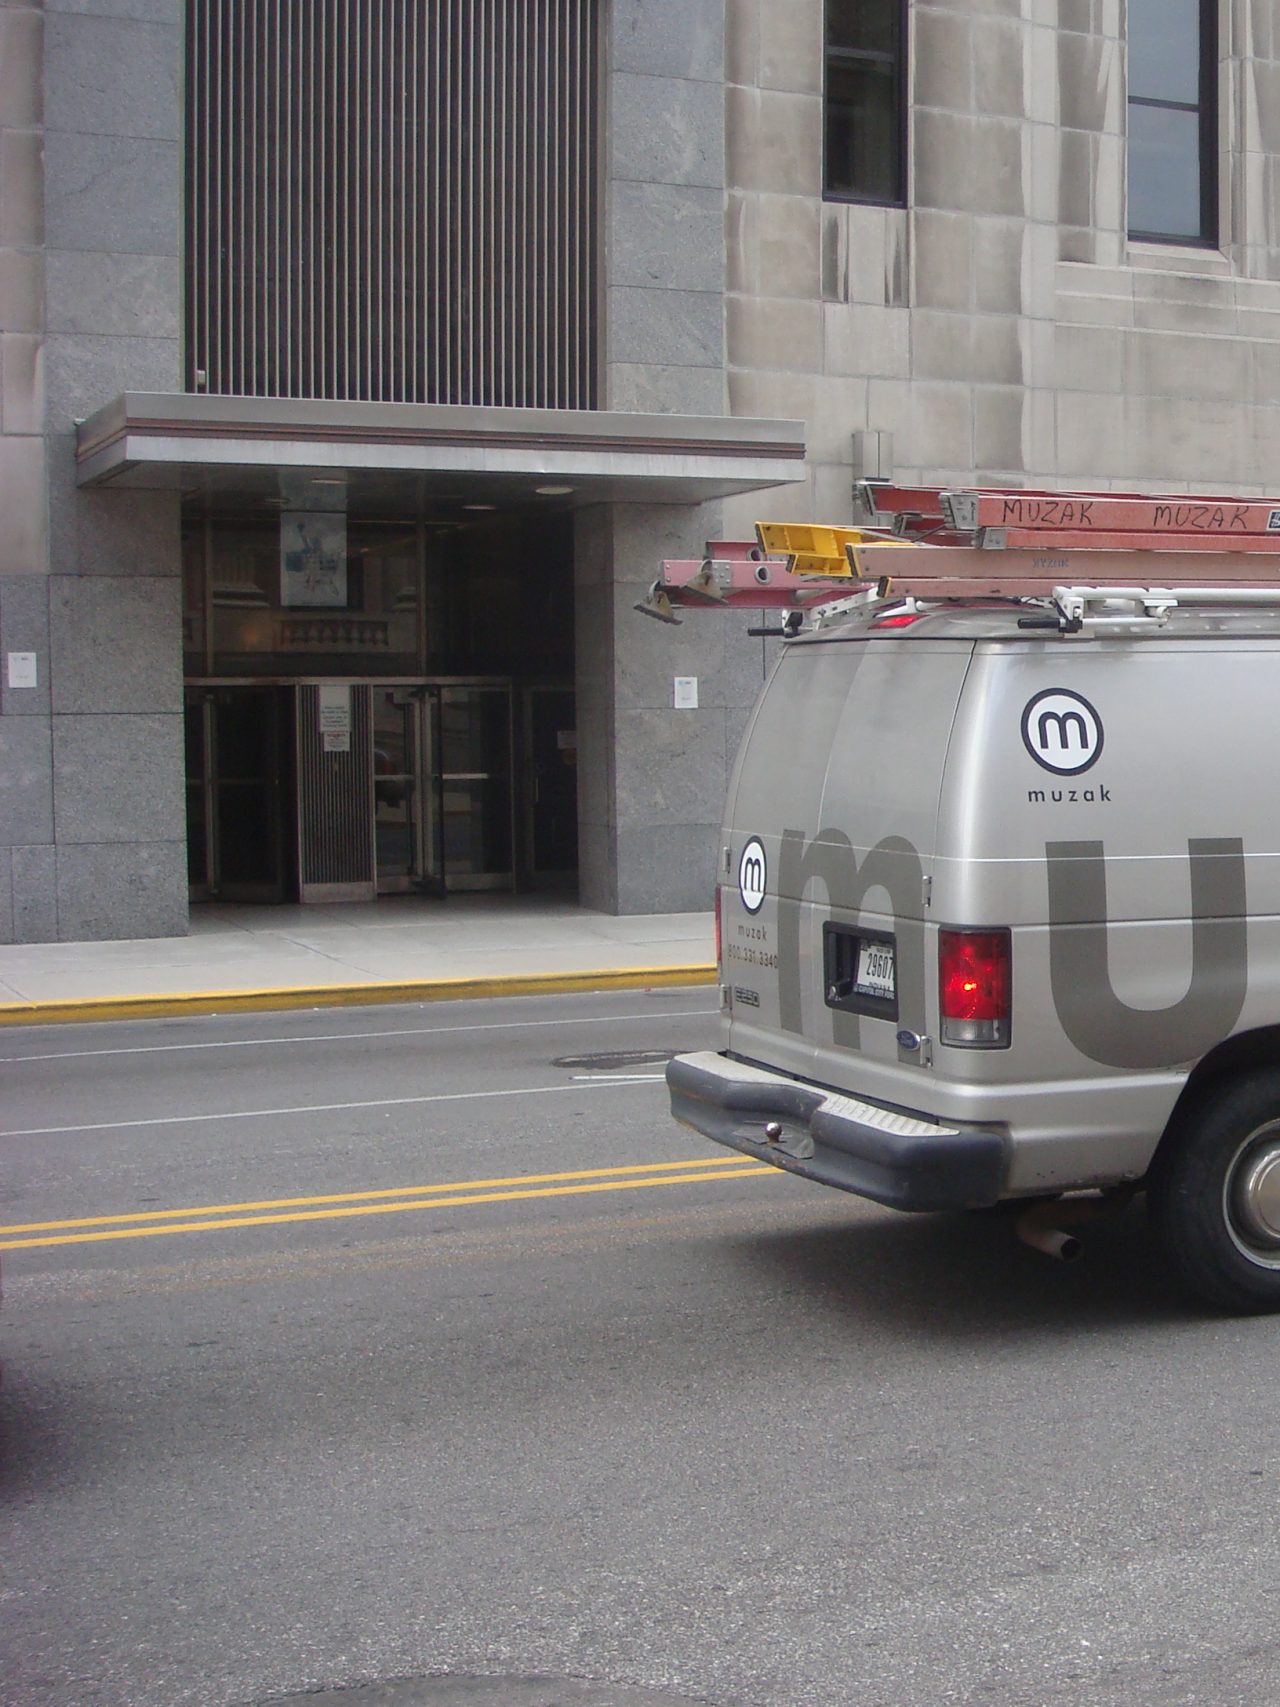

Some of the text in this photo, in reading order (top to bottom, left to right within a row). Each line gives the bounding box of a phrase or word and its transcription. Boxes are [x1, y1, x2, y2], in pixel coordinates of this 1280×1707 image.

[1003, 499, 1095, 525] MUZAK
[1153, 505, 1248, 529] MUZAK
[1038, 711, 1089, 749] m
[1028, 784, 1111, 802] muzak
[738, 924, 767, 941] muzak
